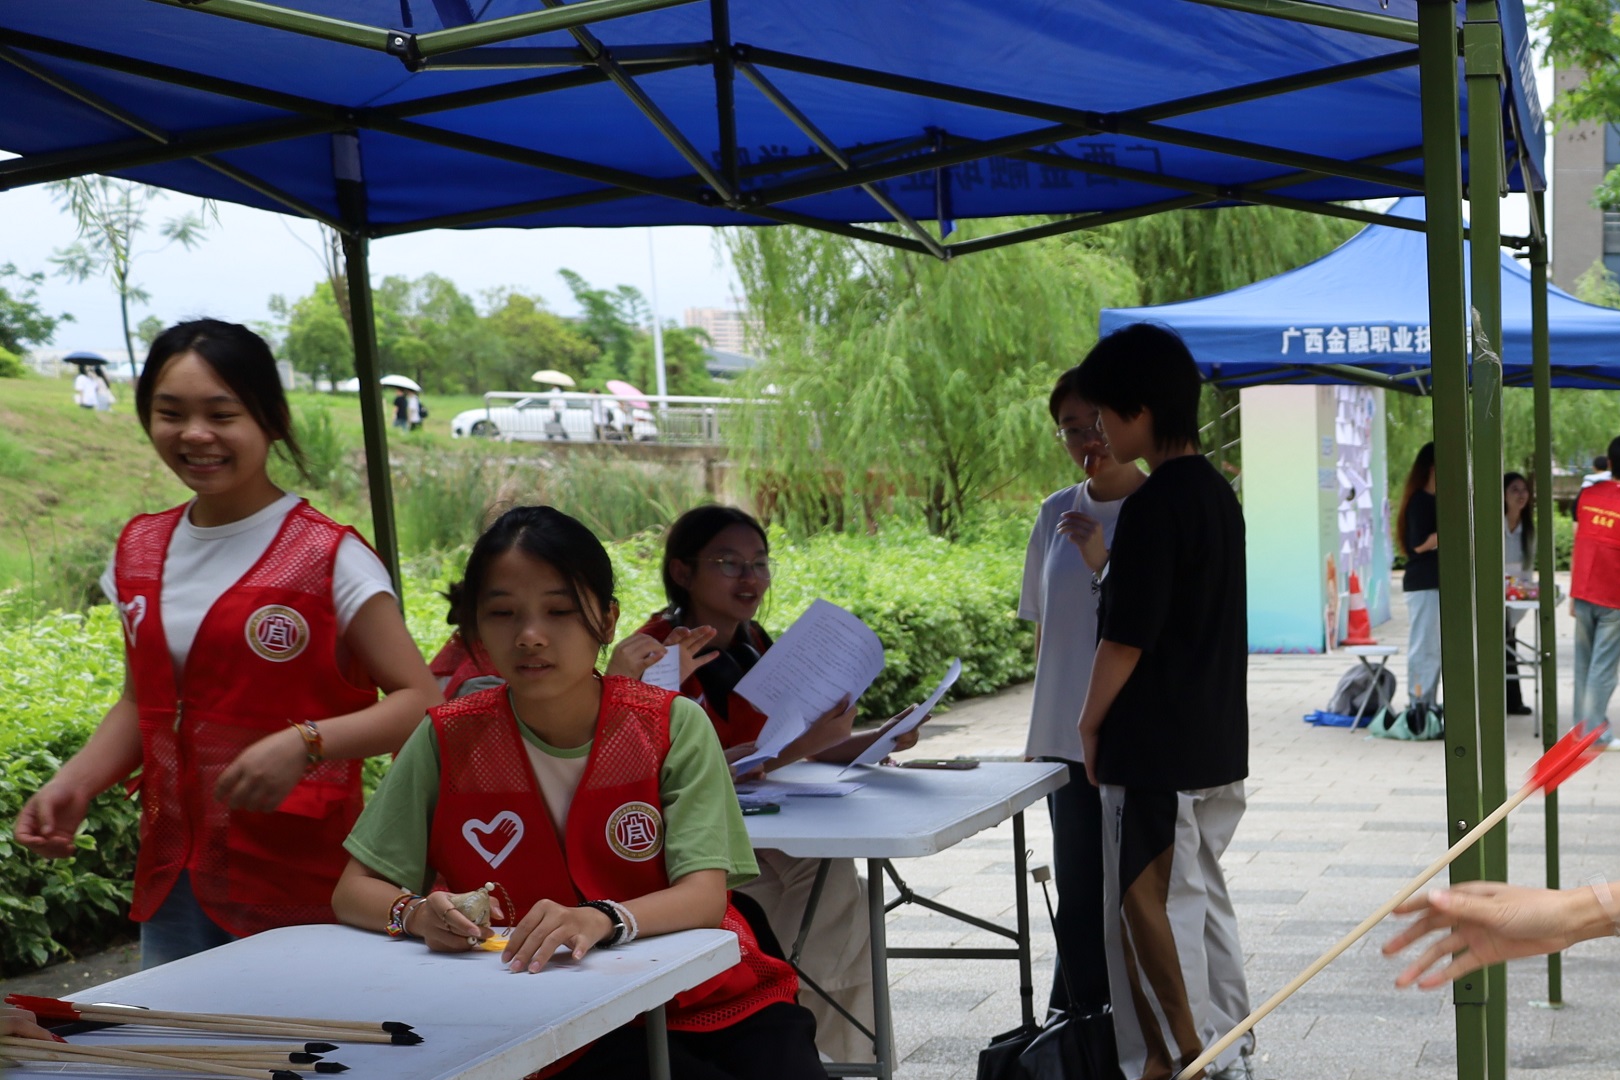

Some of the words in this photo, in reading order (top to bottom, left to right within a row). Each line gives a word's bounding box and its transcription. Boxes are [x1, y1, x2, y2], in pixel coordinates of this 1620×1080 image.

[1281, 325, 1472, 355] 广西金融职业技
